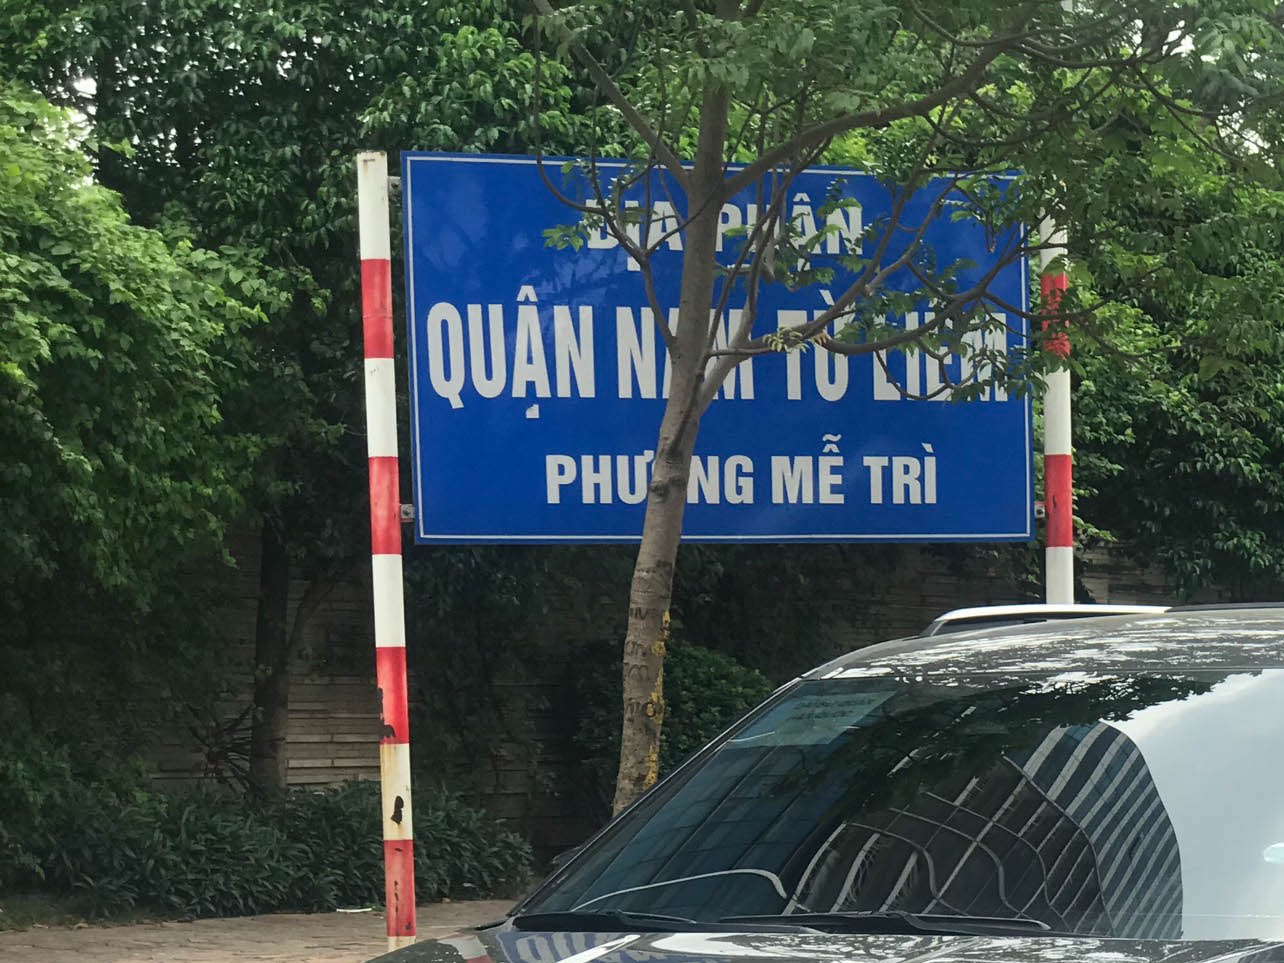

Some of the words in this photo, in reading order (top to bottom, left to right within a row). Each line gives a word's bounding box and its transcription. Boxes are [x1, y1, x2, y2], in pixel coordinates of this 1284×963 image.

[427, 284, 596, 419] QUẬN
[616, 306, 755, 400] NM
[545, 449, 754, 505] PHƯNG
[770, 433, 845, 505] MỄ
[863, 442, 937, 504] TRÌ
